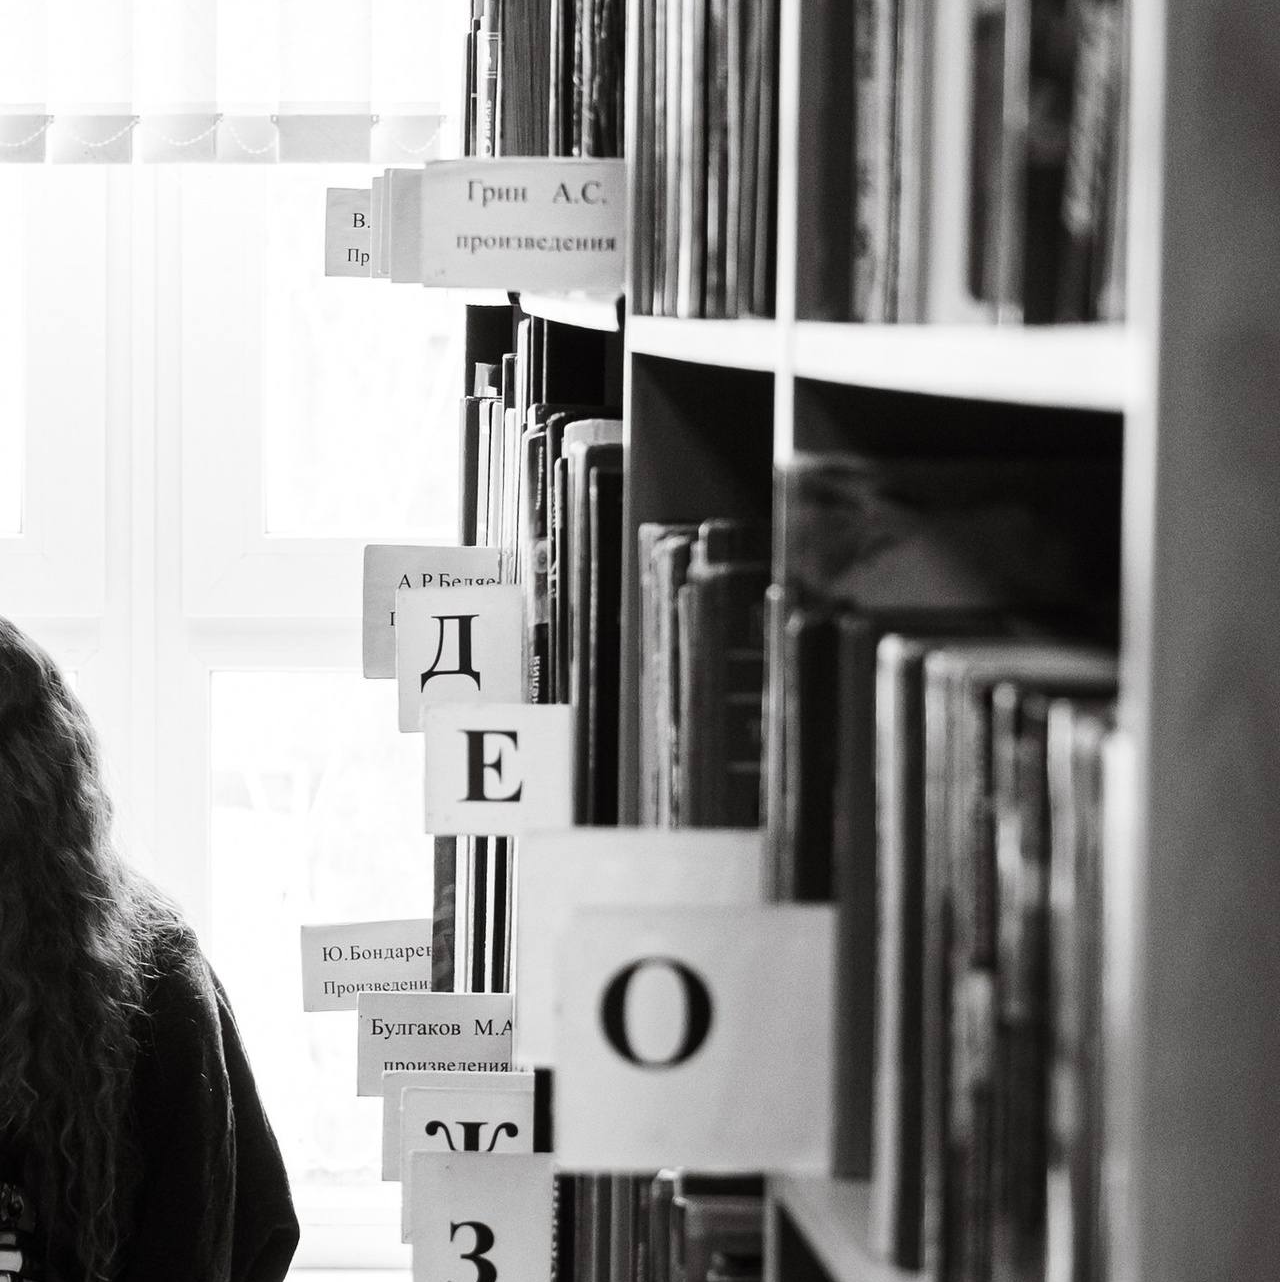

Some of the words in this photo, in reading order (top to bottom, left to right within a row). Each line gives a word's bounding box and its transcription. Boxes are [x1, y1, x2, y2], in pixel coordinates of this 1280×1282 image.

[467, 180, 530, 208] Грин
[352, 211, 372, 230] В.
[456, 232, 618, 255] произведения
[420, 613, 481, 693] Д
[457, 729, 524, 803] Е
[323, 979, 432, 998] Произведени
[597, 954, 716, 1072] О
[370, 1017, 461, 1040] Булгаков
